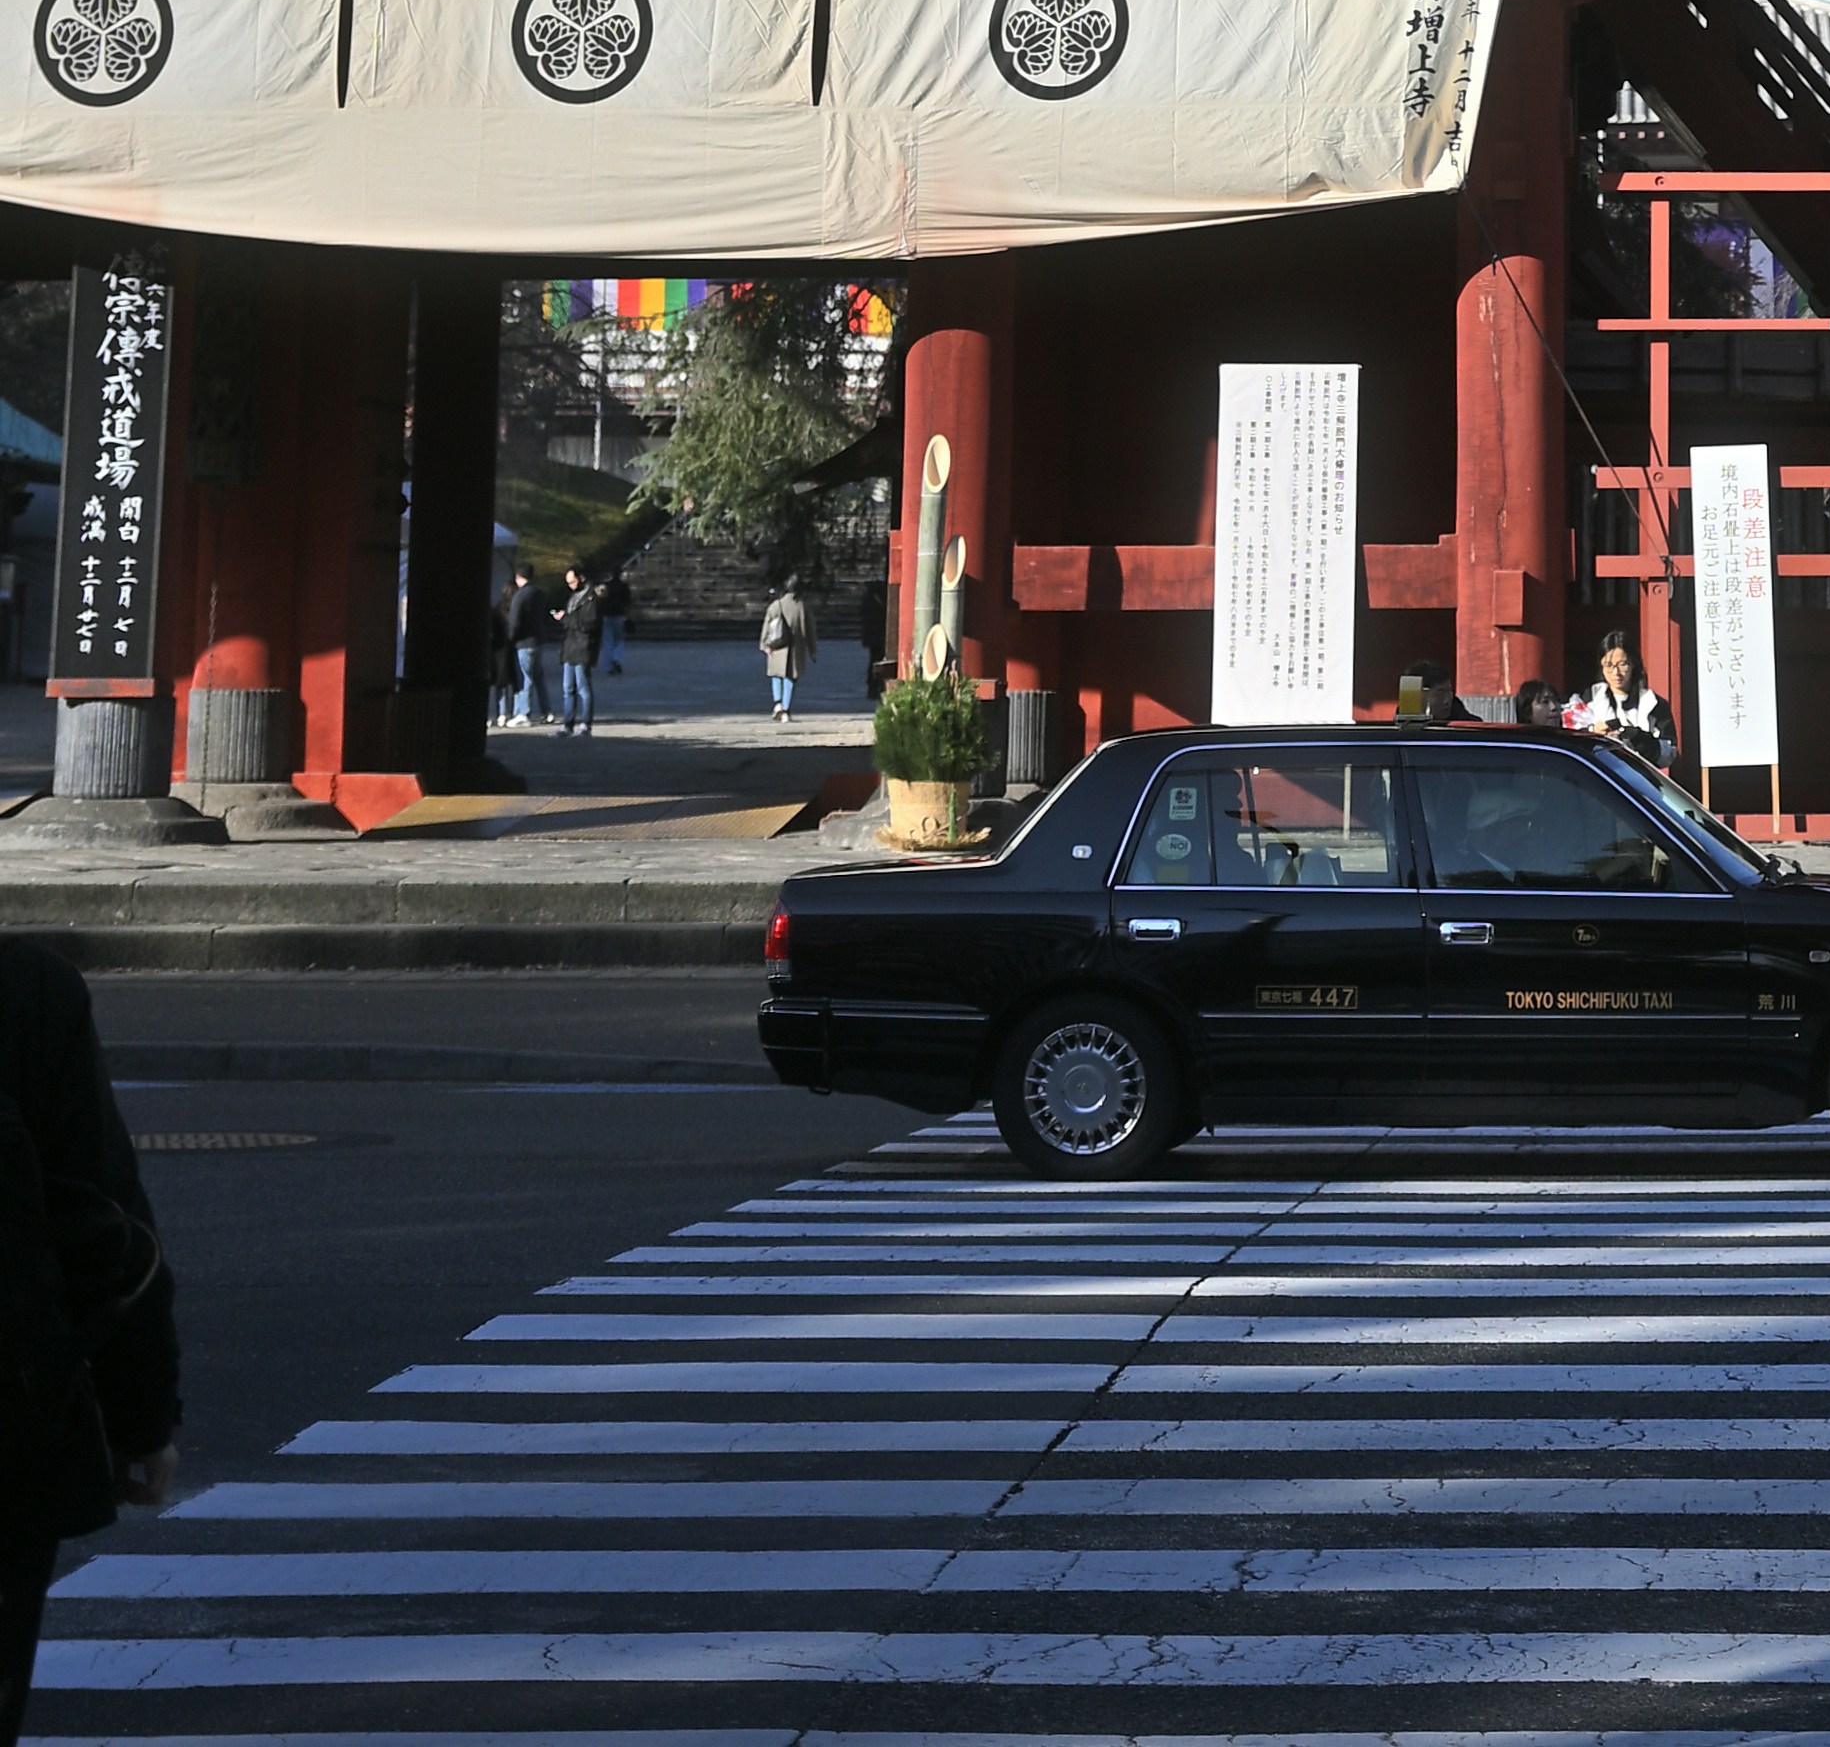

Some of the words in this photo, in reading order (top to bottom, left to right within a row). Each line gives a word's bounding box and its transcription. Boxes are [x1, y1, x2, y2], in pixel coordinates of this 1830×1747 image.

[1701, 505, 1723, 673] お足元ご注意下さい
[1721, 464, 1746, 729] 境内石畳上は段差がございます
[1742, 487, 1767, 599] 段差注意
[1310, 988, 1354, 1007] 447
[1506, 991, 1554, 1009] TOKYO
[1557, 992, 1639, 1009] SHICHIFUKU
[1643, 992, 1673, 1009] TAXI
